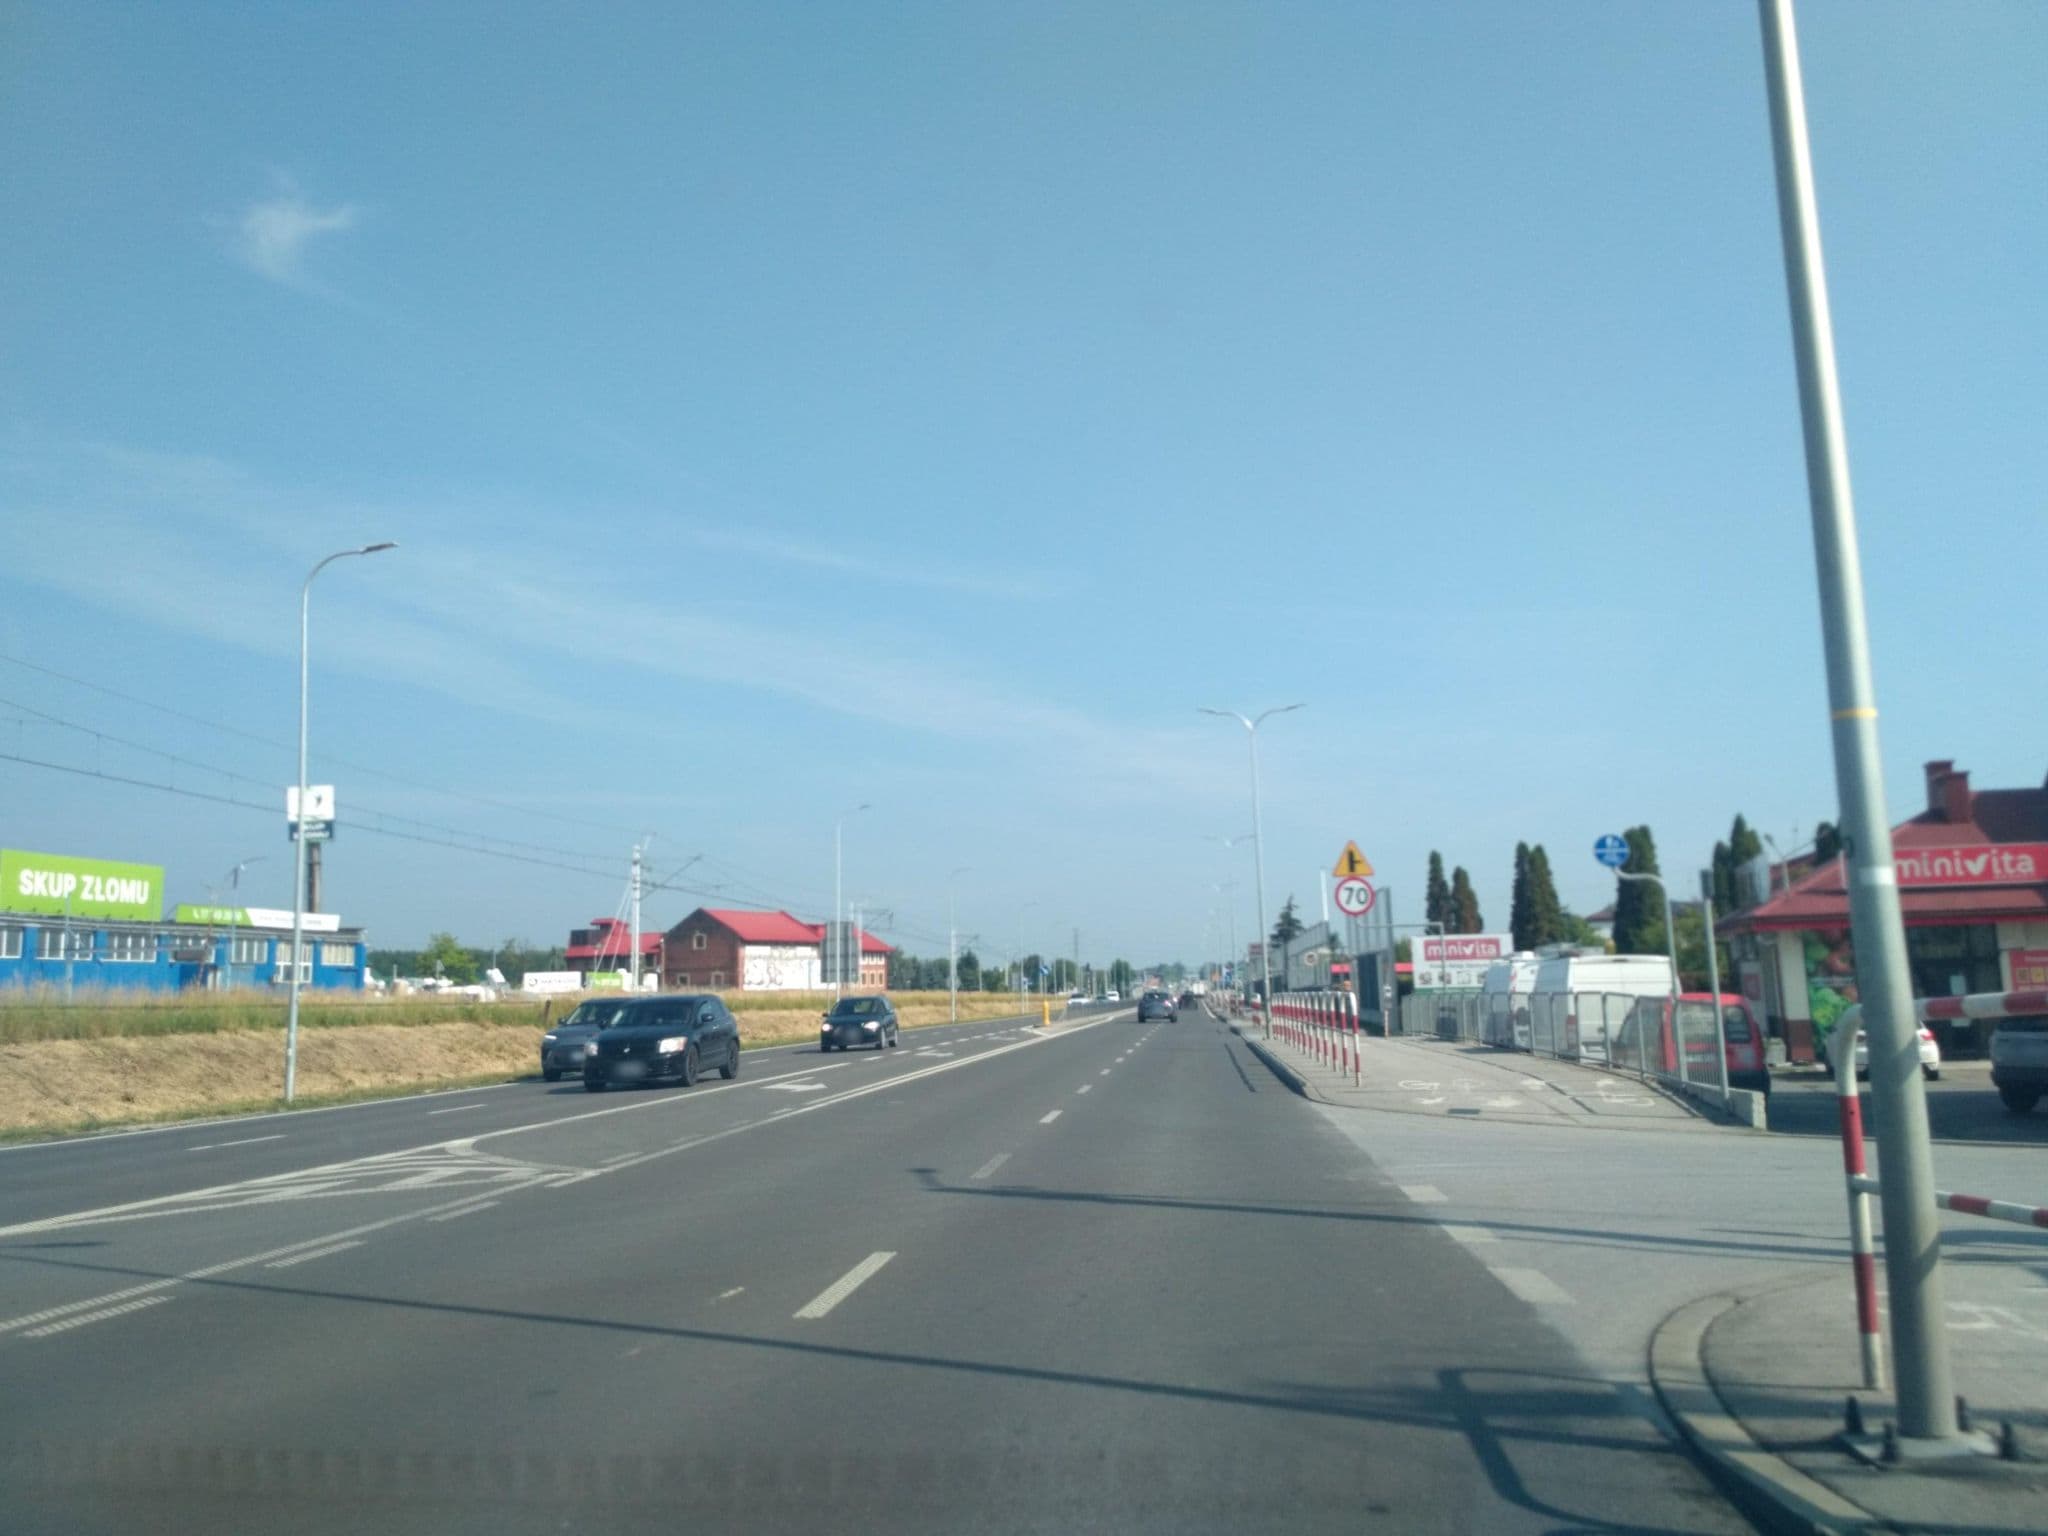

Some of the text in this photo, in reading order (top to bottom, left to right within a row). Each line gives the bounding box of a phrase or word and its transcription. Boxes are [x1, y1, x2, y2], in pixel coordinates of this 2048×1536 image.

[1895, 849, 2034, 878] minivita
[19, 868, 149, 905] SKUP ZŁOMU
[1344, 887, 1369, 905] 70
